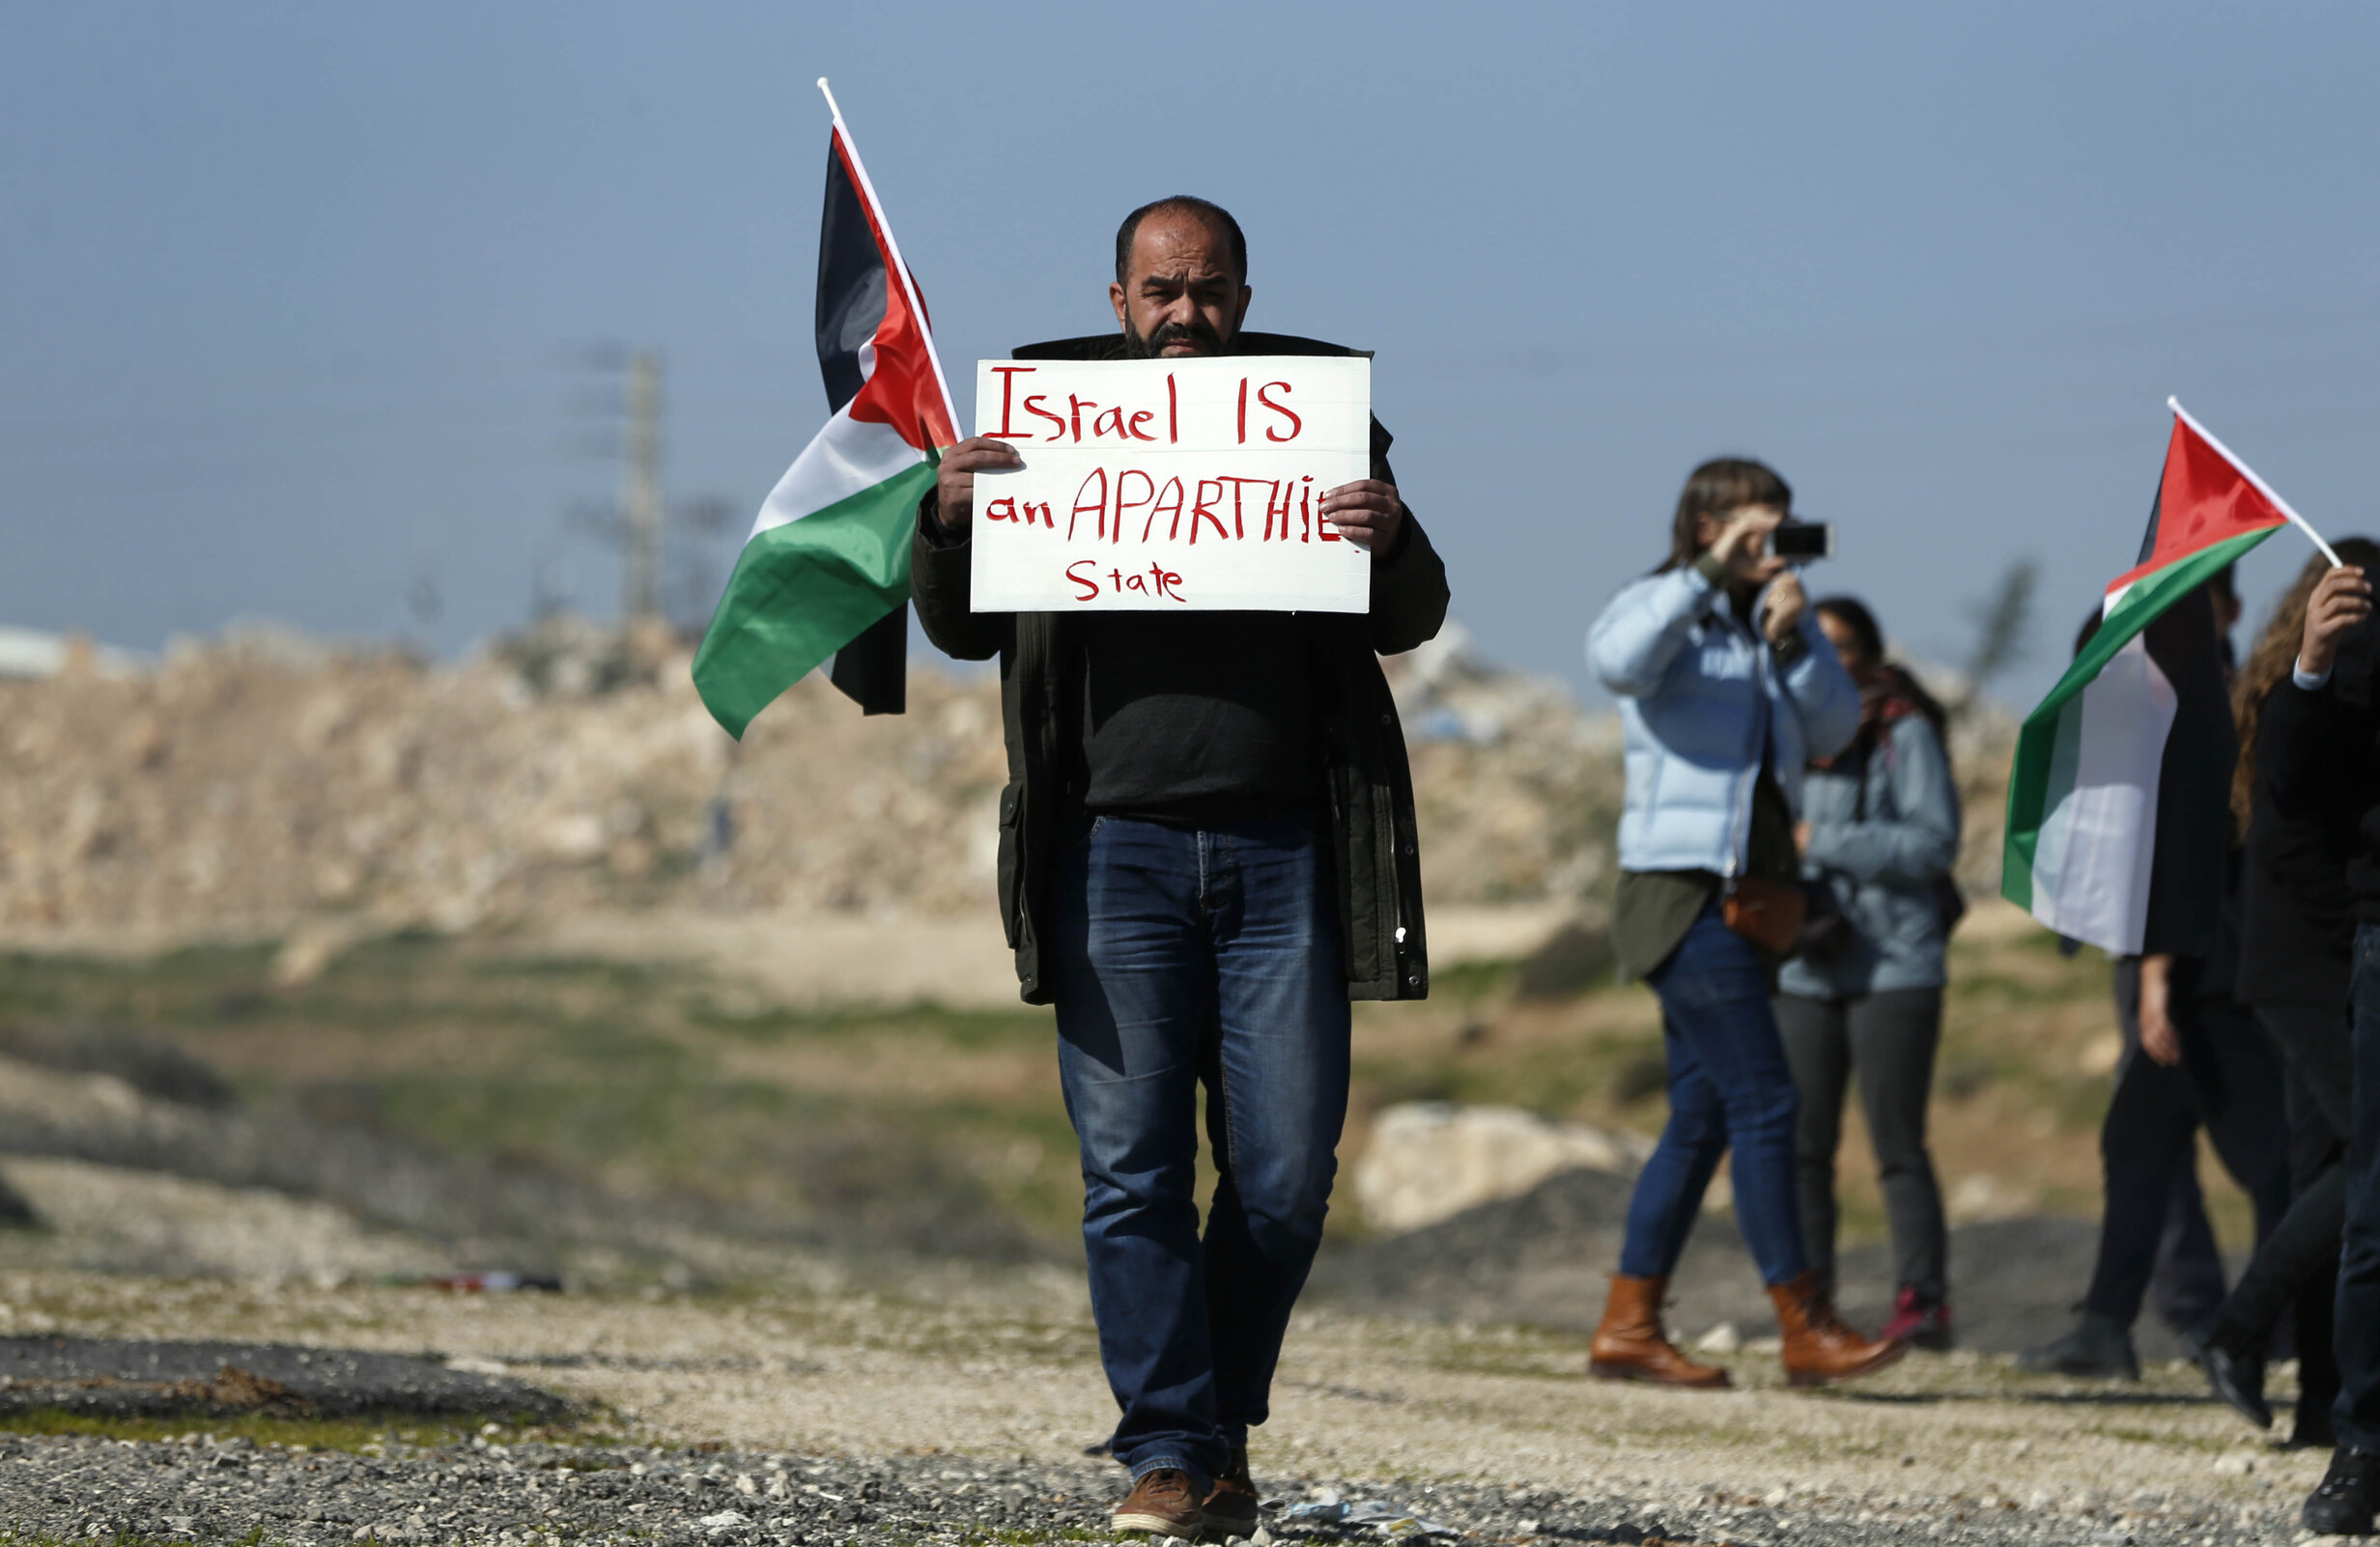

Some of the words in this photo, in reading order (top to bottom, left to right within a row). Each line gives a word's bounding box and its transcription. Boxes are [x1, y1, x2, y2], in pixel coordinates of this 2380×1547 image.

[981, 367, 1178, 444] Israel
[1237, 376, 1302, 444] IS
[986, 496, 1055, 529] an
[1066, 561, 1187, 603] State
